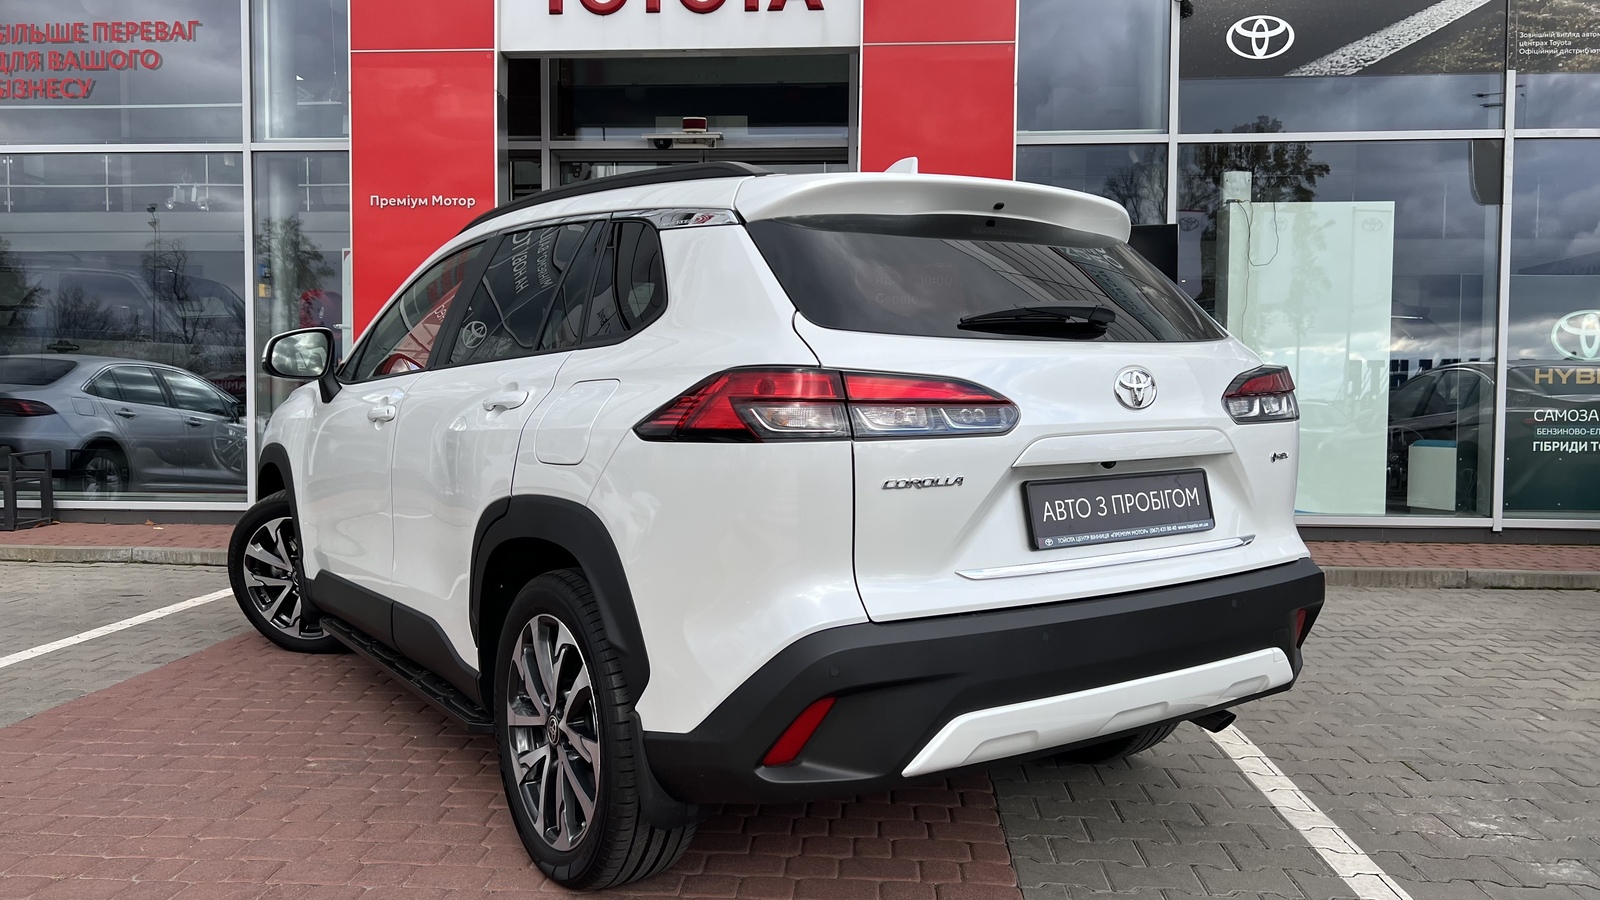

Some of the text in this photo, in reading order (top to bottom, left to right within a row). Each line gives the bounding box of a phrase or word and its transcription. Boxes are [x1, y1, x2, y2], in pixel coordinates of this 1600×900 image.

[92, 20, 201, 42] ПЕРЕВАГ
[1556, 31, 1580, 39] вигляд
[1549, 39, 1572, 47] Toyota
[1519, 47, 1558, 55] Офіційний
[48, 49, 160, 70] ВАШОГО
[370, 194, 476, 209] Преміум Мотор
[1533, 409, 1600, 422] САМОЗА
[1532, 441, 1587, 453] ГІБРИДИ
[881, 474, 965, 490] COROLLA
[1043, 498, 1091, 522] АВТО
[1111, 487, 1200, 515] ПРОБІГОМ
